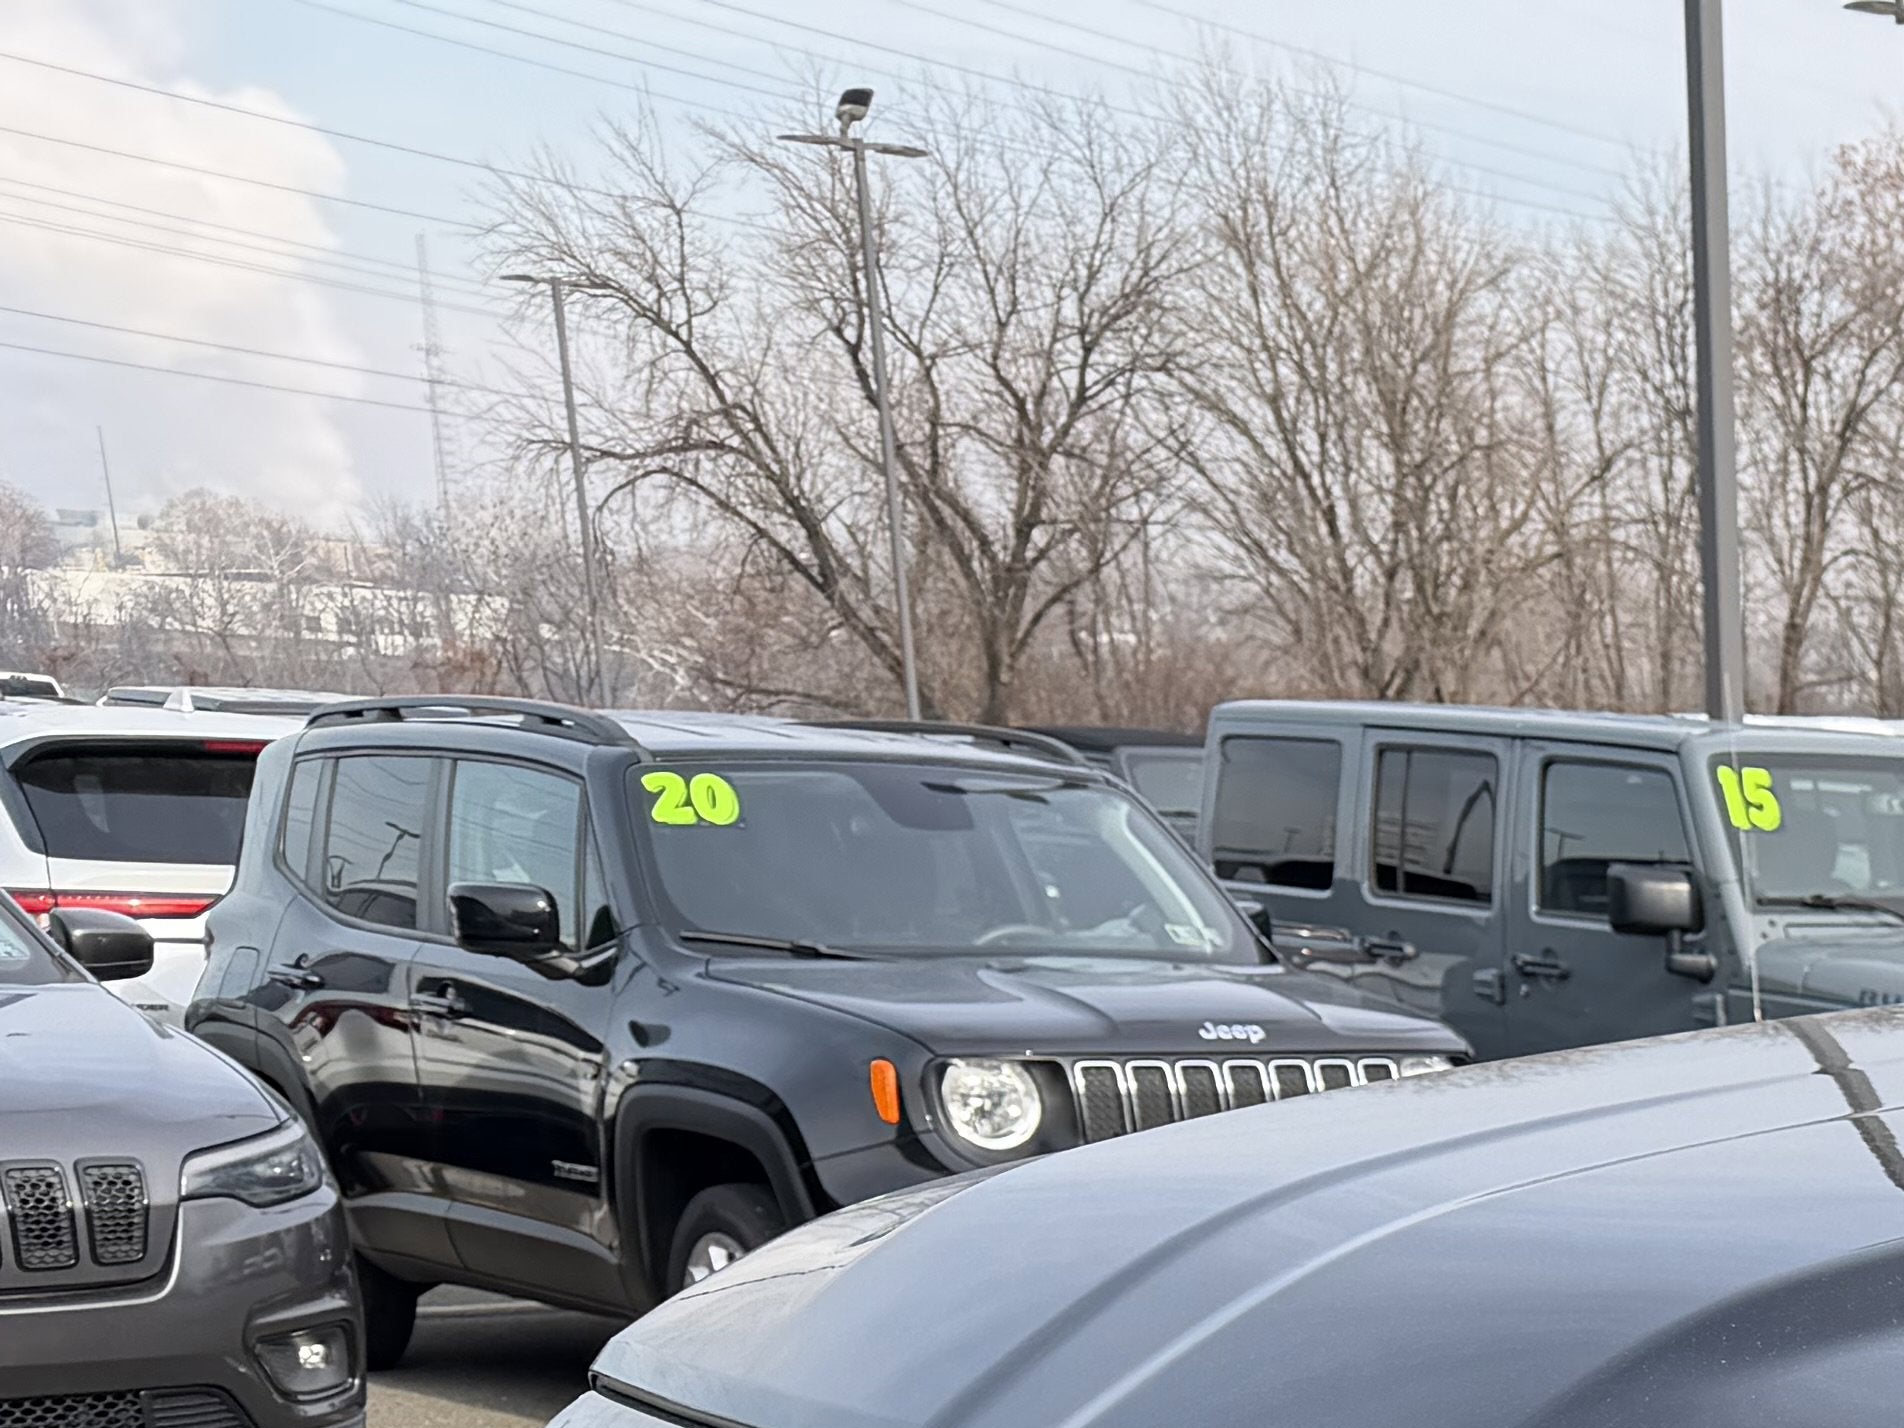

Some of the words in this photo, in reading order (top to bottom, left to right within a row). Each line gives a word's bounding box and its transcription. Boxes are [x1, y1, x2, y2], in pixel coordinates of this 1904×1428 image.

[641, 771, 740, 826] 20
[1716, 765, 1781, 832] 15
[1198, 1021, 1267, 1045] Jeep
